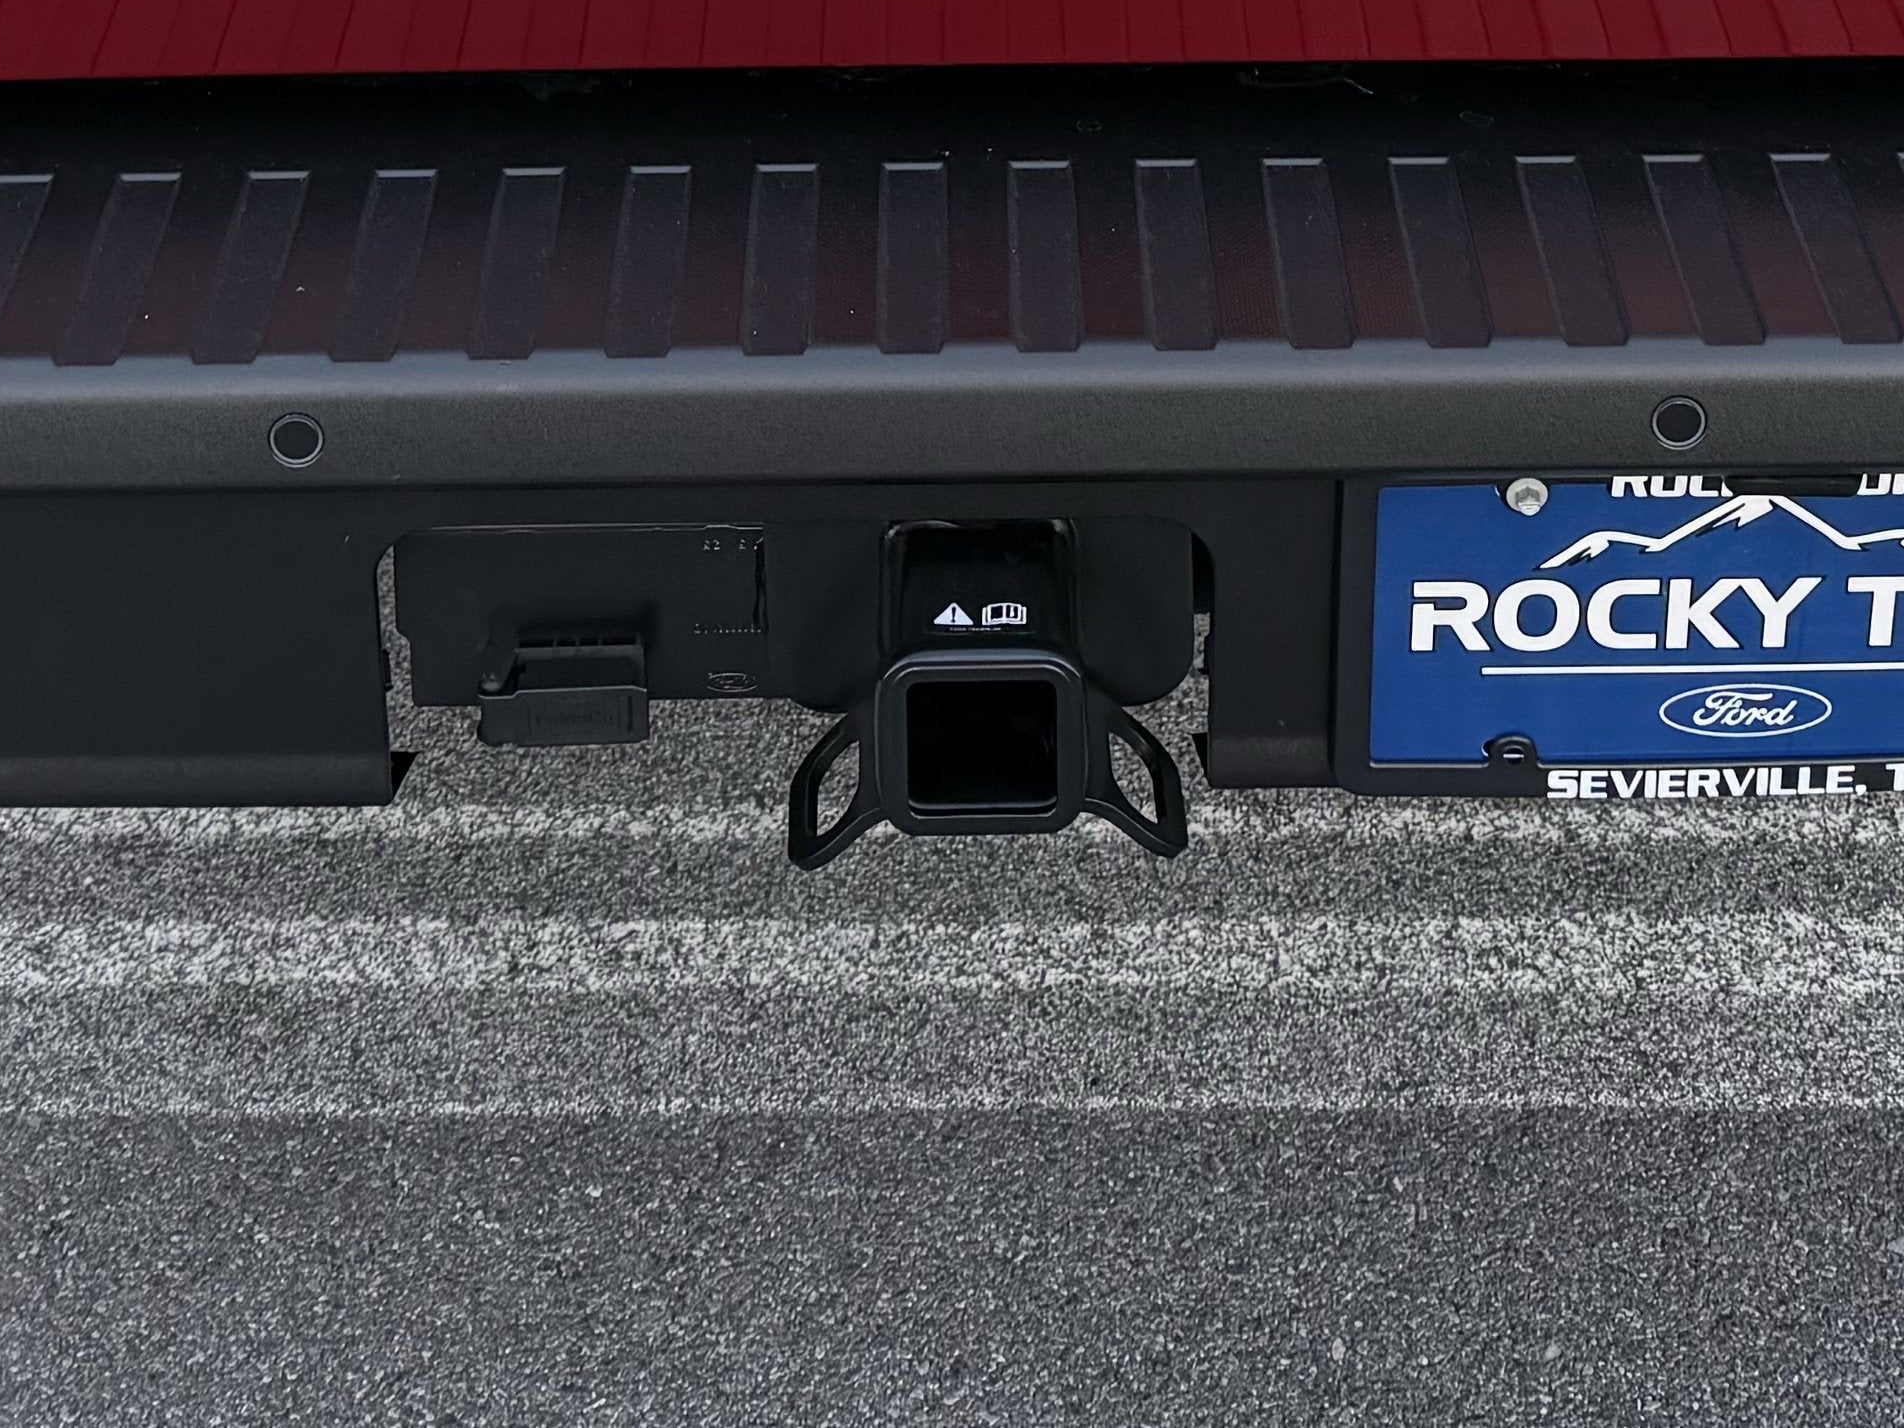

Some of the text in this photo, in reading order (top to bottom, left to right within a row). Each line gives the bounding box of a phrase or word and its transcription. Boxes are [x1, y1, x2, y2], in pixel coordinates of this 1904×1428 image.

[1409, 575, 1824, 653] ROCKY
[1692, 690, 1798, 726] Ford
[1546, 765, 1867, 799] SEVIERVILLE,
